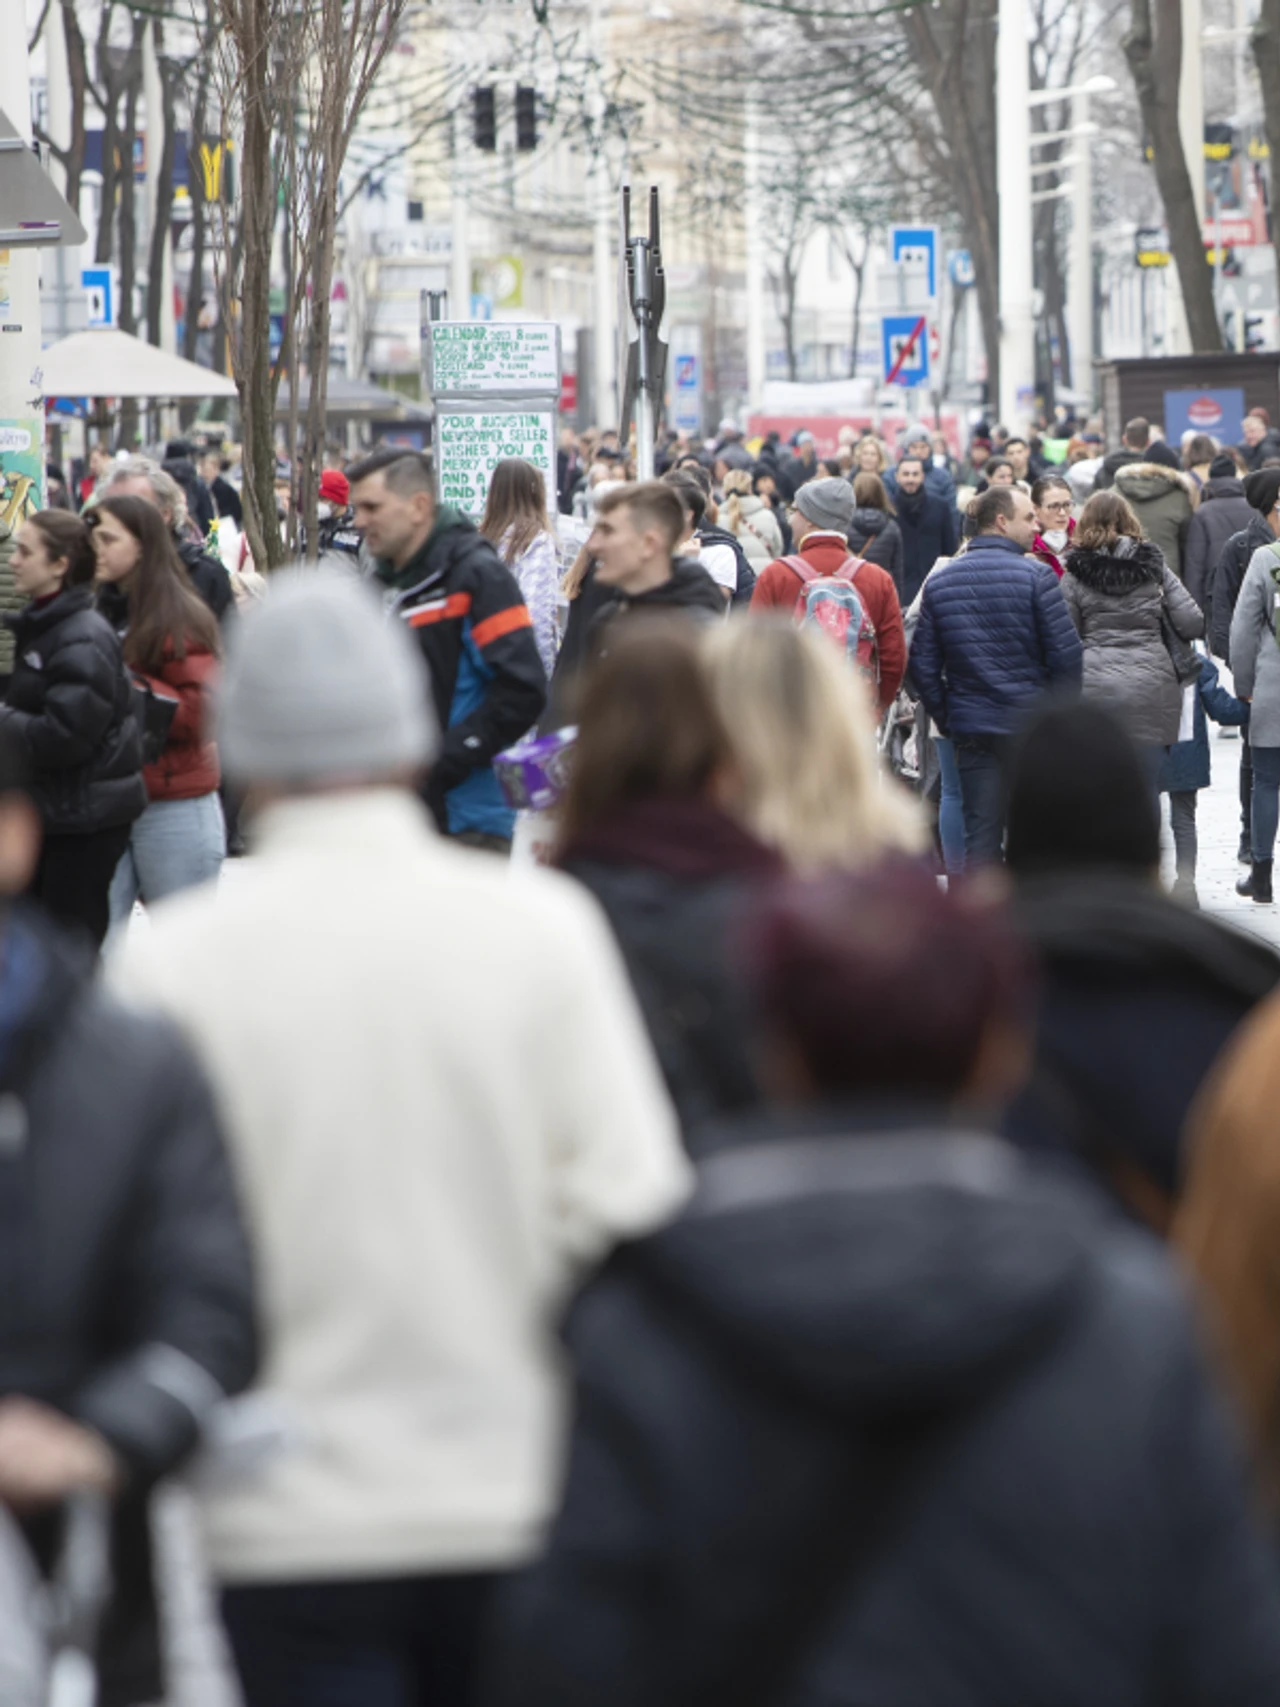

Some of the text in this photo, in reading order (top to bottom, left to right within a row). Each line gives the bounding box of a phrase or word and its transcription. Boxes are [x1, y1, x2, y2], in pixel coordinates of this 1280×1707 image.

[442, 415, 475, 428] YOUR
[510, 429, 548, 441] SELLER
[442, 442, 544, 456] WISHES YOU A
[442, 457, 481, 470] MERRY
[442, 472, 485, 484] AND A
[444, 486, 475, 498] AND
